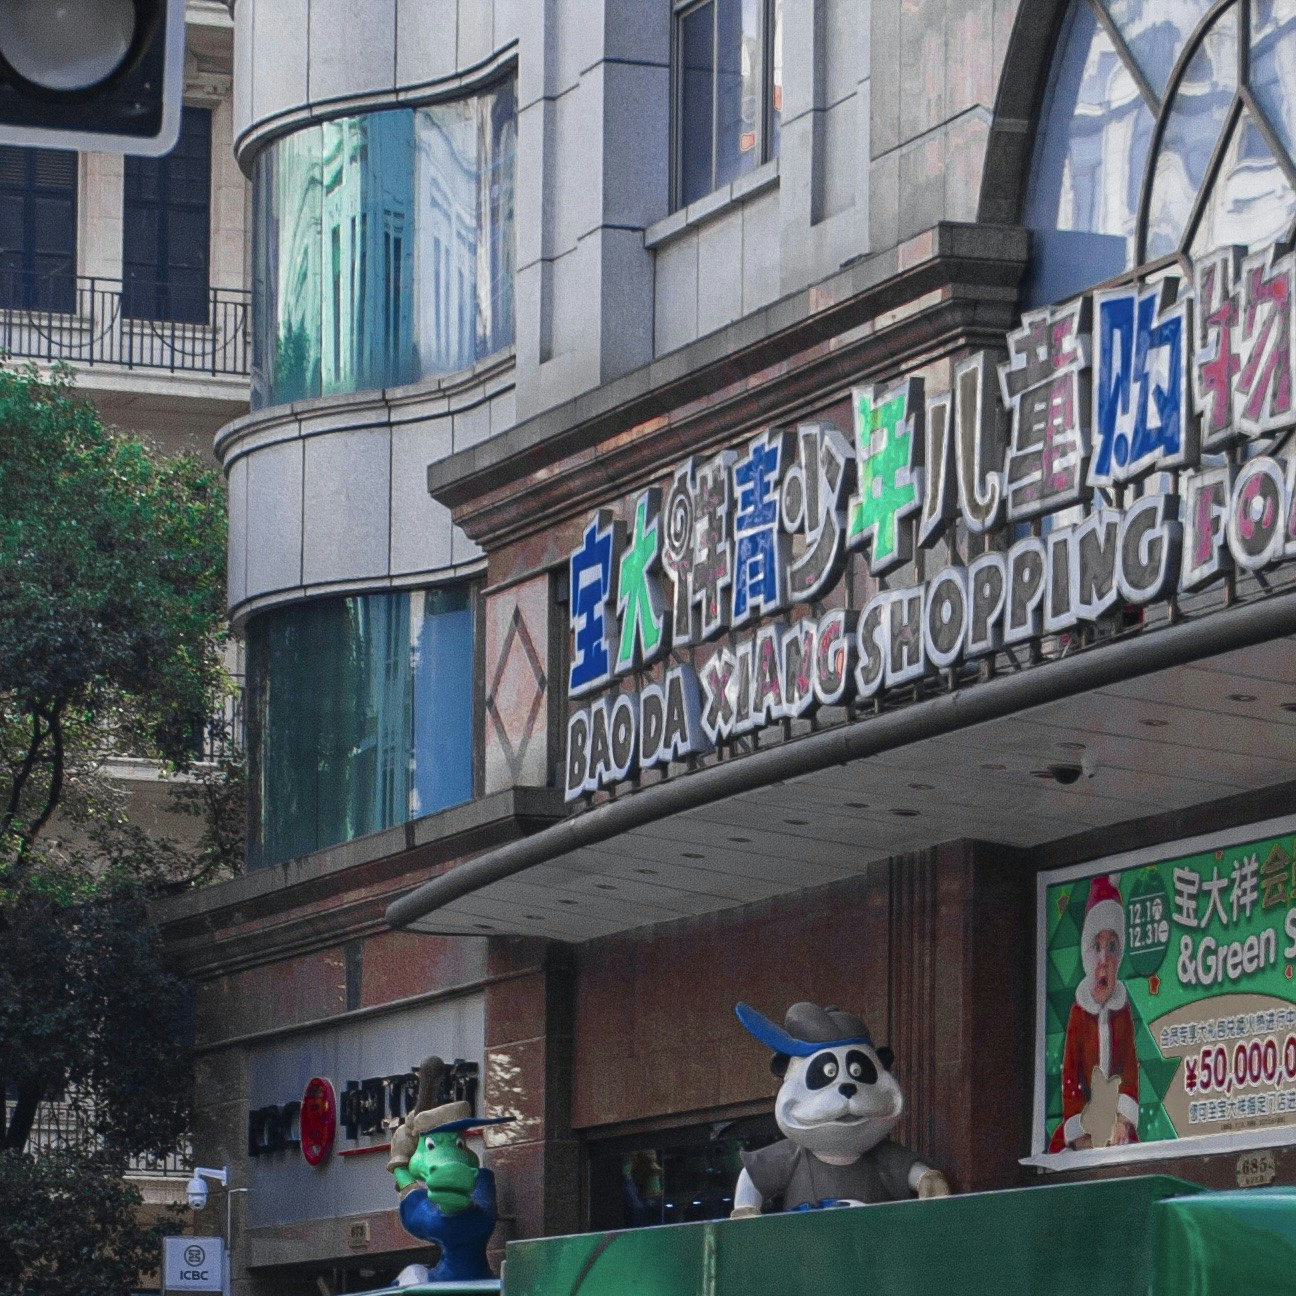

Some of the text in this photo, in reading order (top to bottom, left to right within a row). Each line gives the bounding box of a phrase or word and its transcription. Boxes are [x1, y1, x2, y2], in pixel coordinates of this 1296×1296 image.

[701, 608, 849, 745] XIANG
[855, 495, 1172, 697] SHOPPING
[1177, 928, 1276, 985] &Green
[179, 1270, 209, 1281] ICBC
